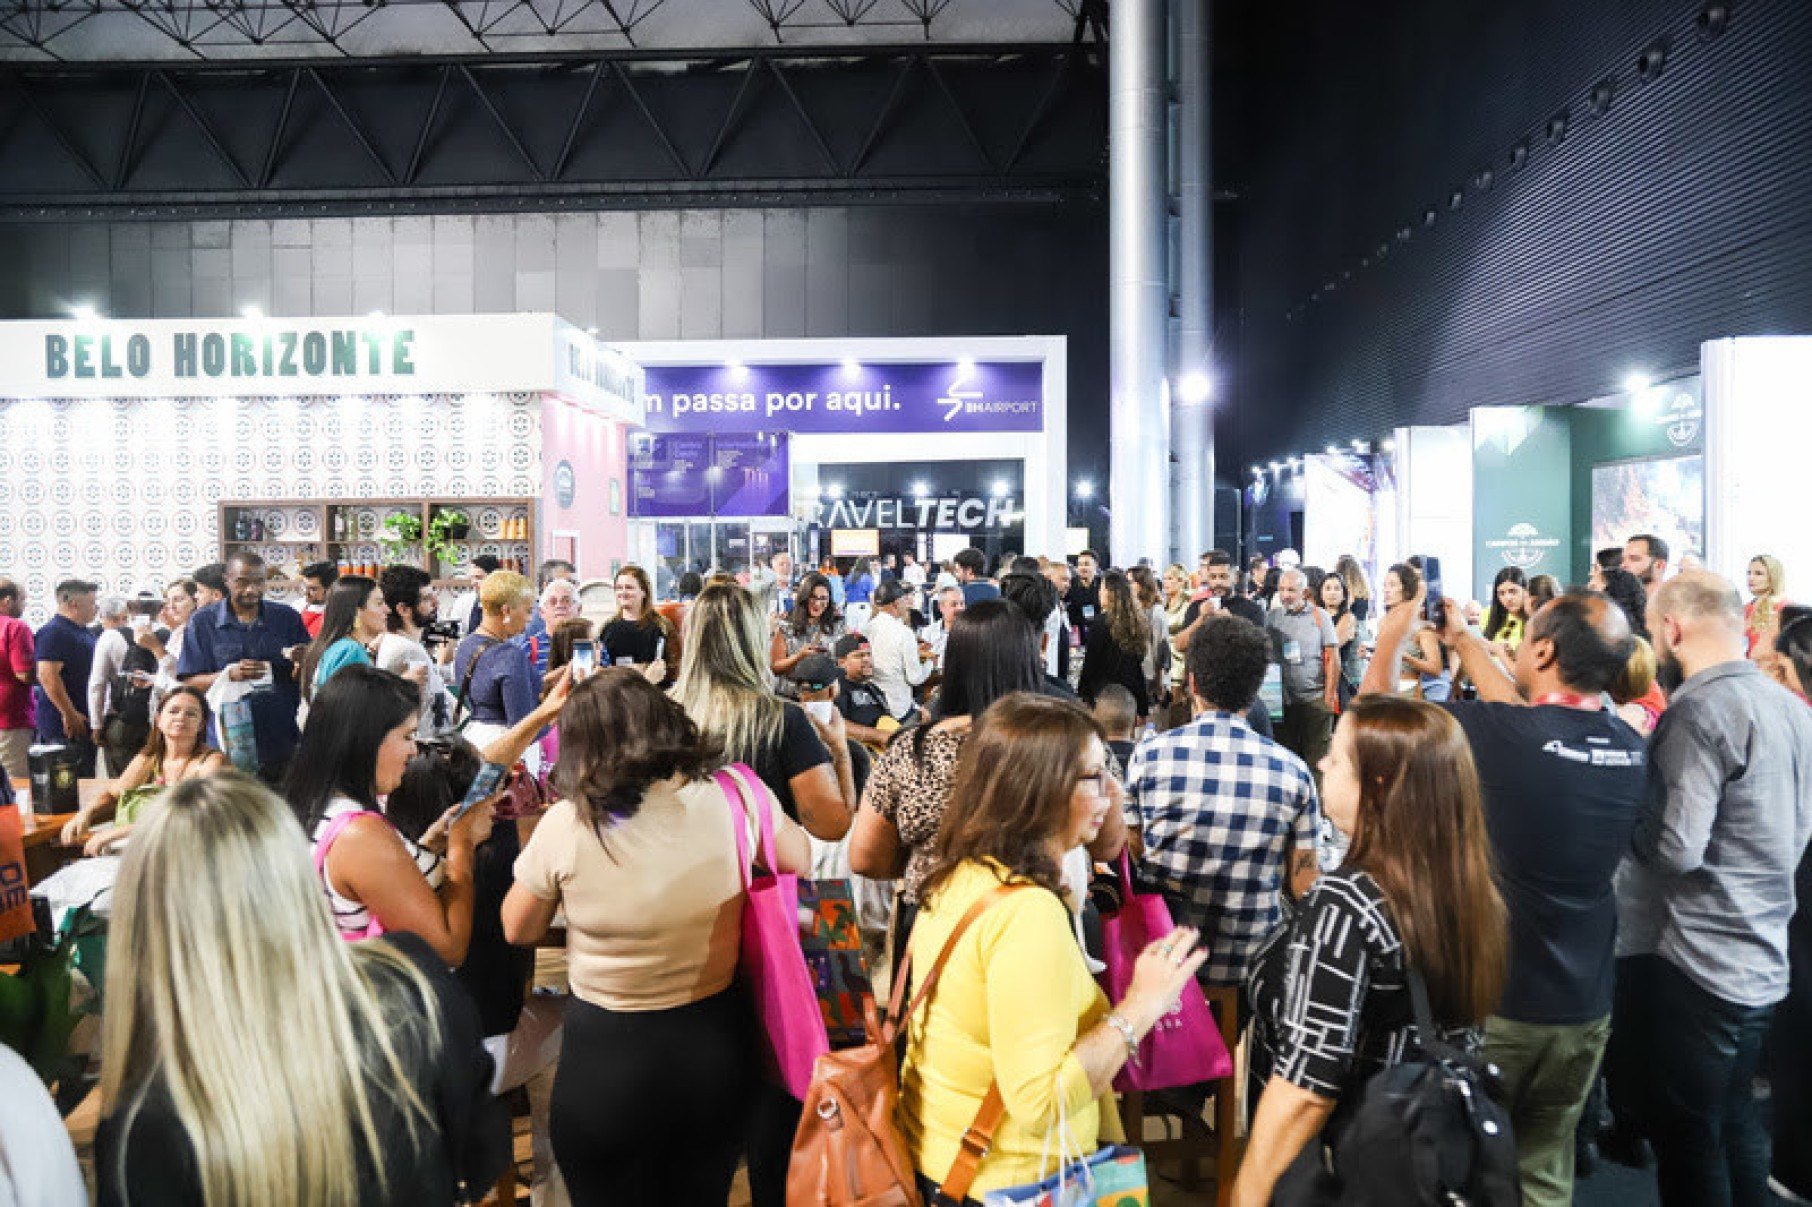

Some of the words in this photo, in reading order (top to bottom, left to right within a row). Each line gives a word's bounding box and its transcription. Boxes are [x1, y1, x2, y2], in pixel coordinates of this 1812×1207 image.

[45, 333, 151, 379] BELO
[173, 330, 415, 378] HORIZONTE
[672, 393, 757, 419] passa
[765, 392, 819, 418] por
[825, 383, 902, 417] aqui.
[809, 497, 1016, 529] RAVELTECH
